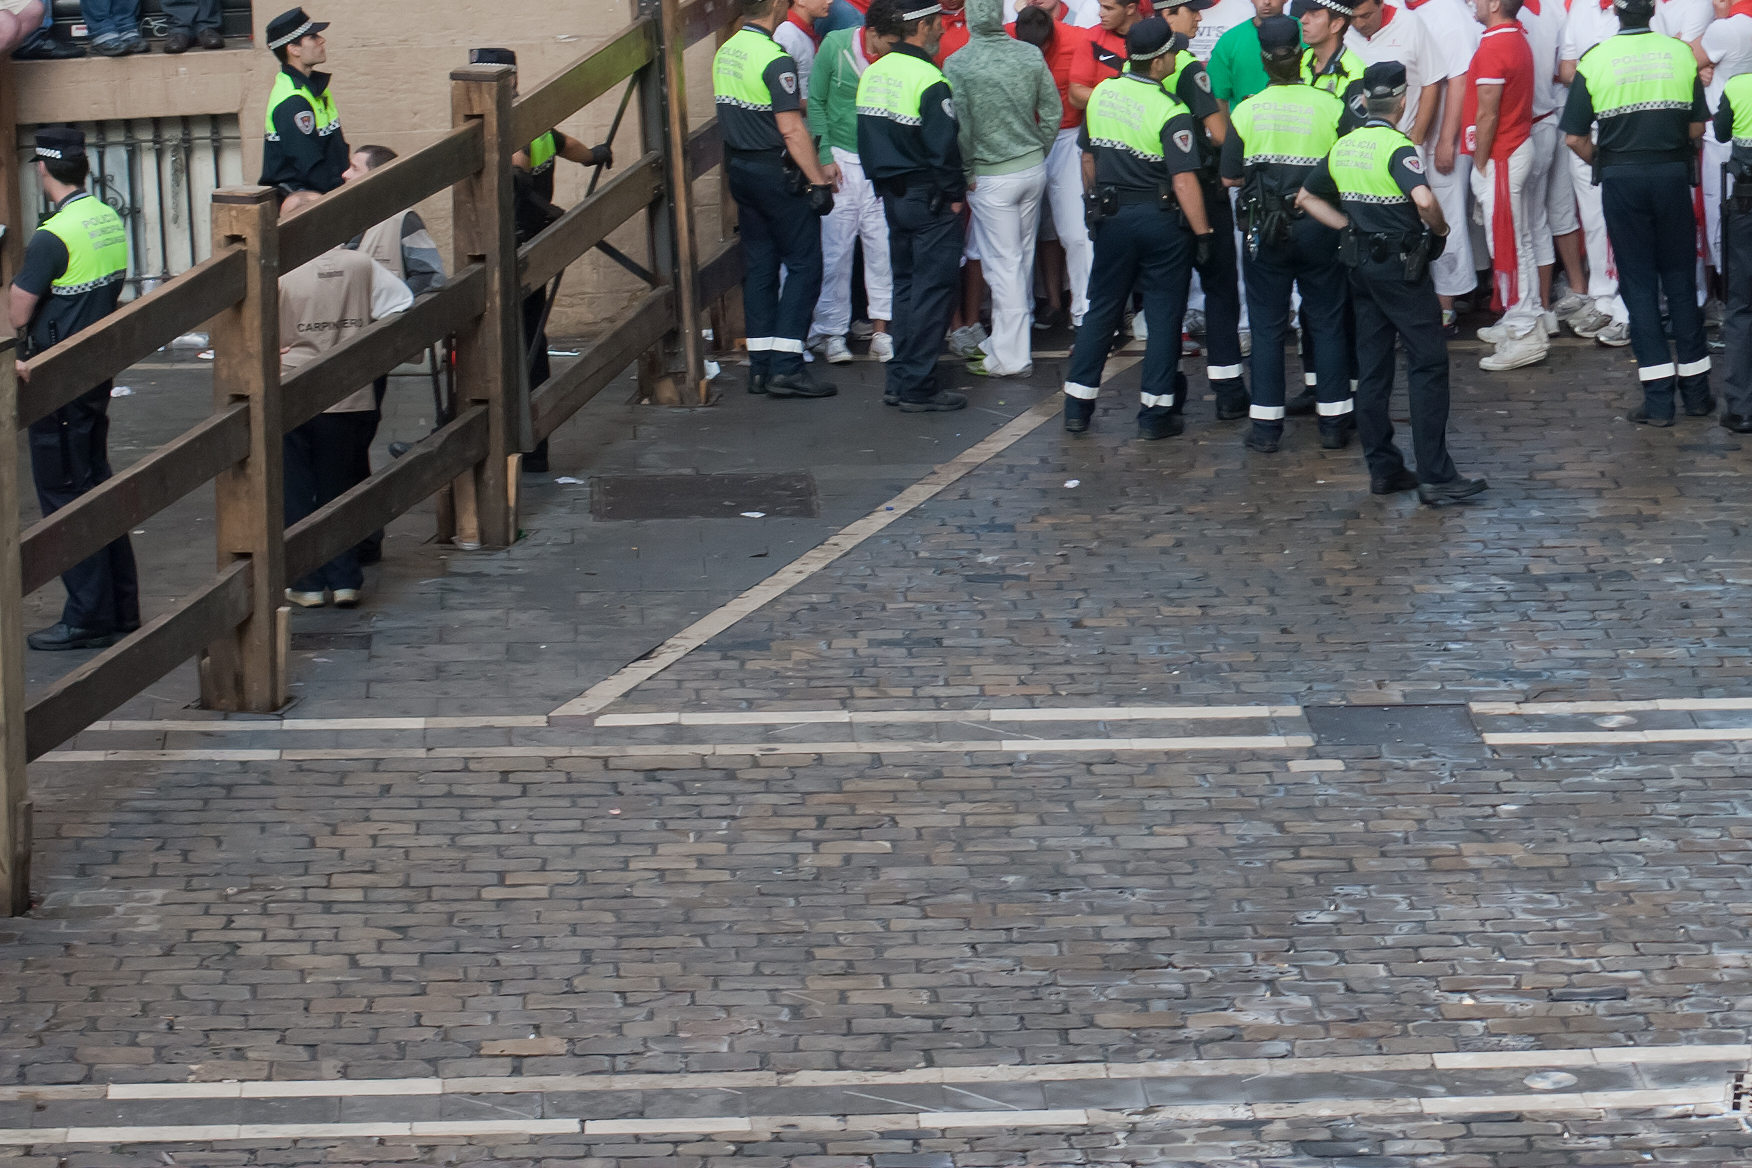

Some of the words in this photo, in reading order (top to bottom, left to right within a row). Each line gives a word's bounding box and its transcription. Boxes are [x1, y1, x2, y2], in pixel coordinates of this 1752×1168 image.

[1612, 52, 1673, 67] POLICIA
[1100, 89, 1145, 113] POLICIA
[1253, 102, 1314, 115] POLICIA
[1339, 139, 1376, 150] POLICIA
